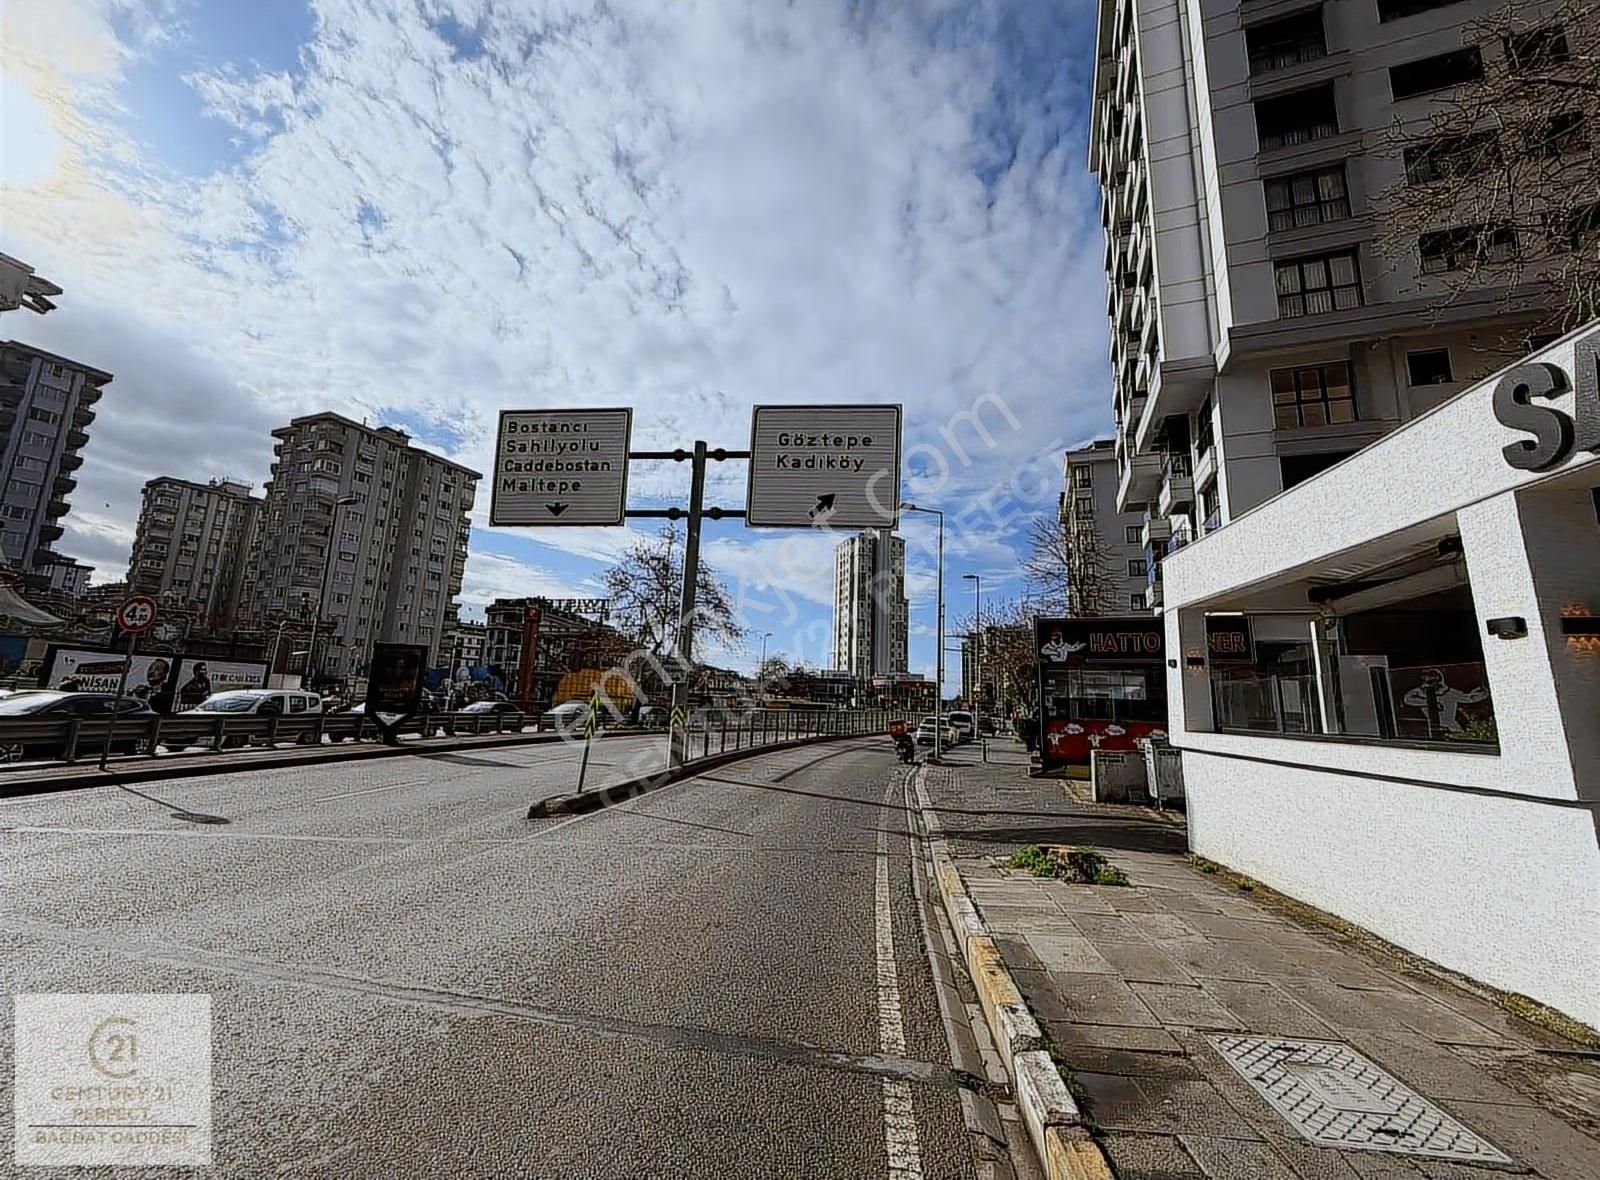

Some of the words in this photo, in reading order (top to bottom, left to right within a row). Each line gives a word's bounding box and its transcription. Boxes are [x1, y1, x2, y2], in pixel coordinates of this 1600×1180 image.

[508, 421, 588, 433] Bostancı
[506, 438, 600, 455] Sahilyolu
[778, 432, 873, 450] Göztepe
[504, 459, 611, 472] Caddebostan
[776, 454, 865, 473] Kadıköy
[502, 478, 581, 495] Maltepe
[1207, 631, 1246, 653] NER
